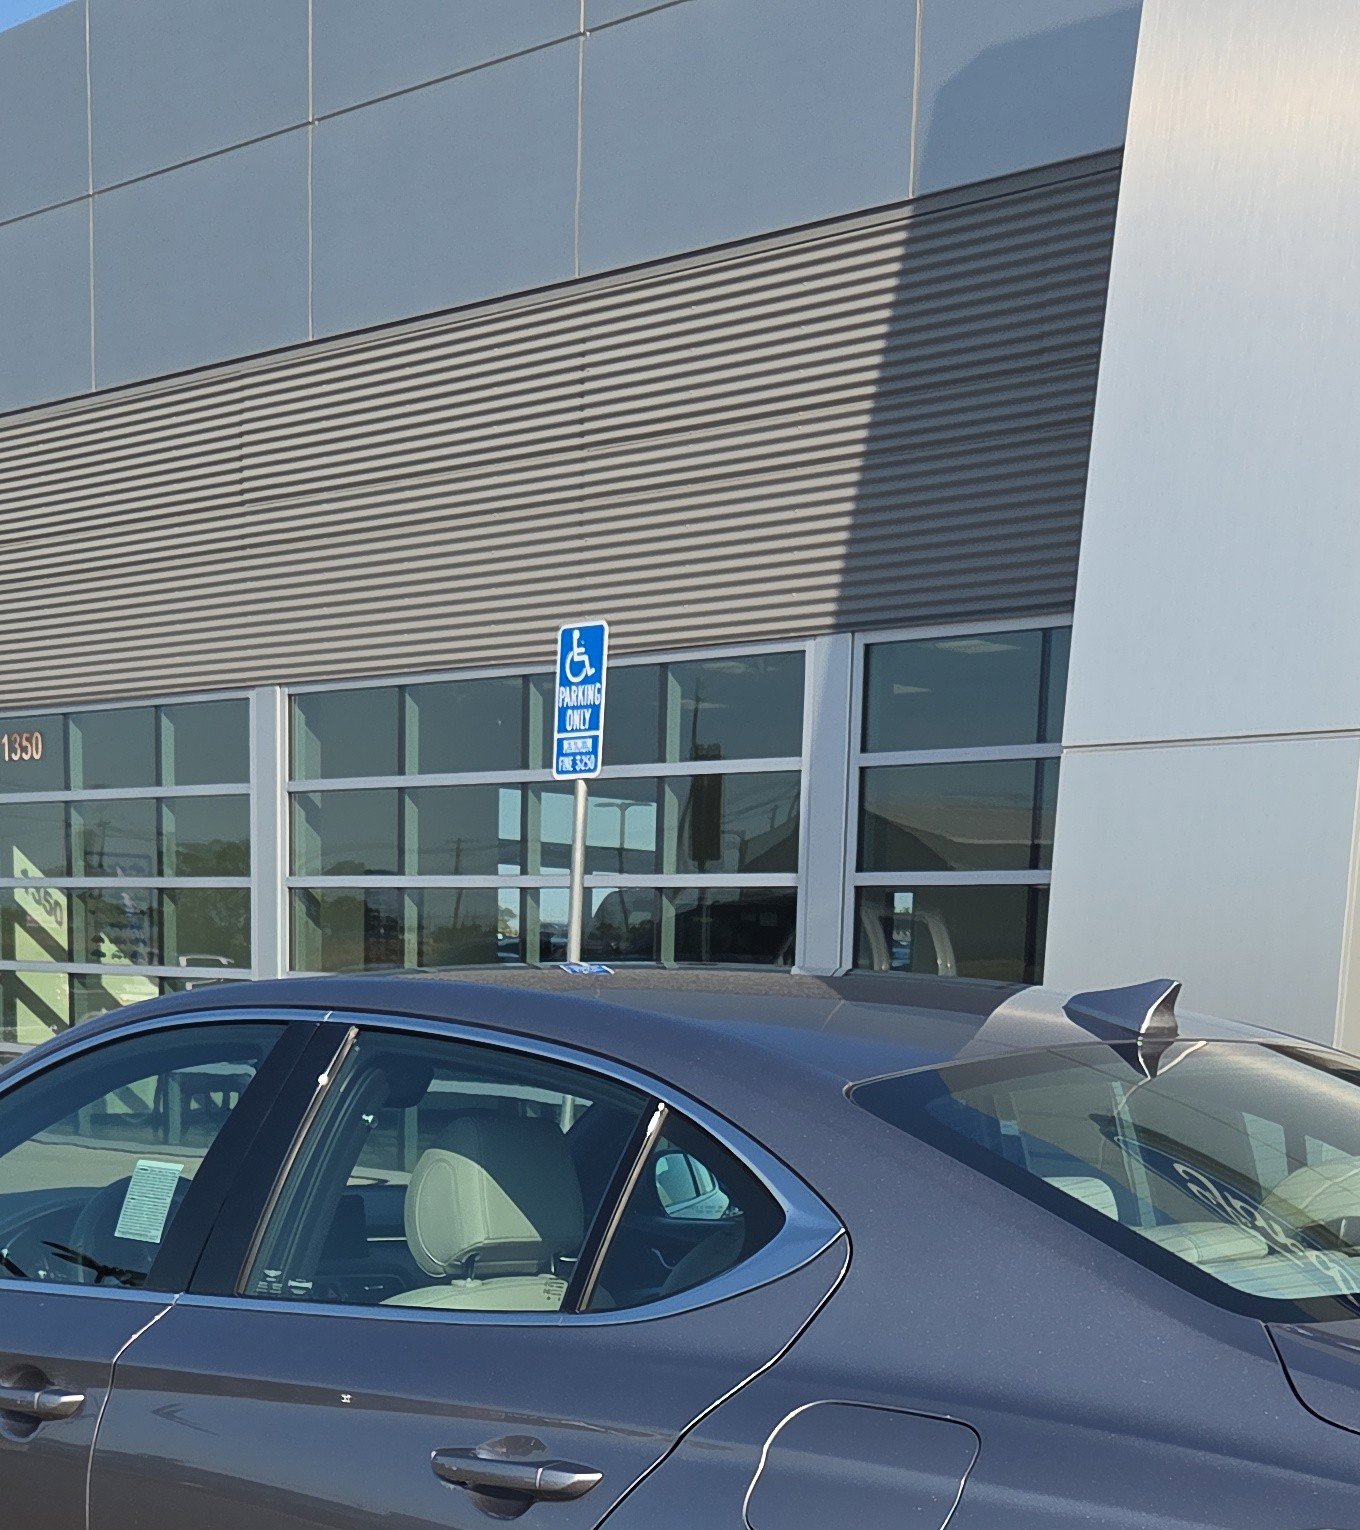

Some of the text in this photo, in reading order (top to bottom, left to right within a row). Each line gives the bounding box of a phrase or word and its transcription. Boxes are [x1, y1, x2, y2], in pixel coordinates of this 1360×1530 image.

[558, 683, 601, 708] PARKING
[565, 708, 592, 731] ONLY
[1, 731, 42, 761] 1350
